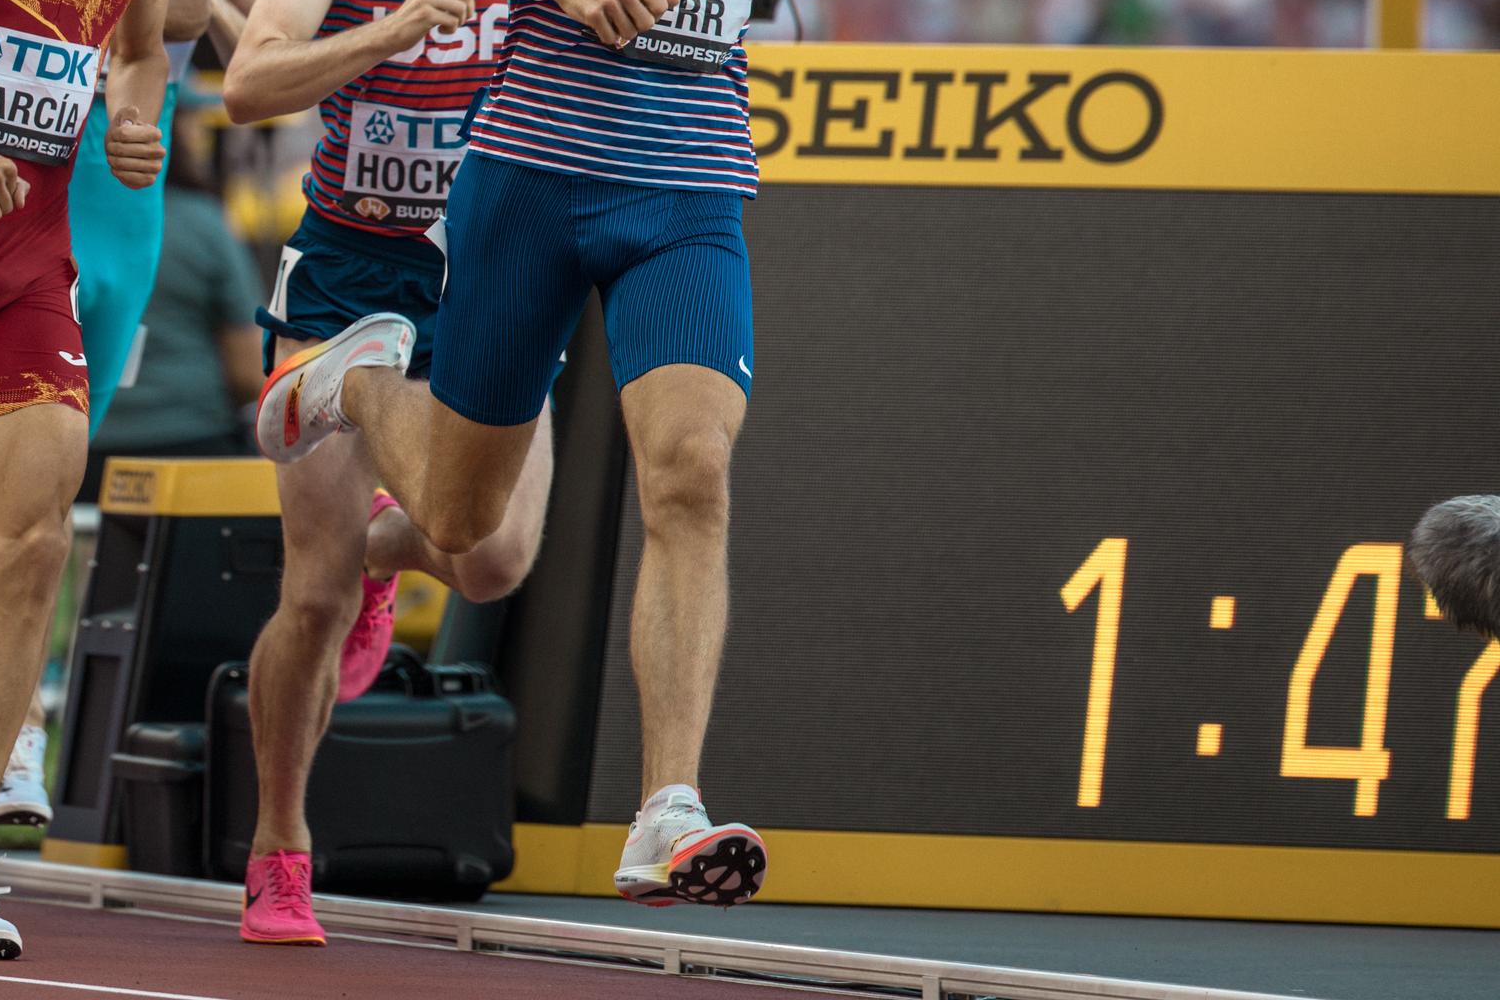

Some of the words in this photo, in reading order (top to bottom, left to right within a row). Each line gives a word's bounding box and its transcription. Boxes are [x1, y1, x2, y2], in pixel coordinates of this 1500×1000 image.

[6, 35, 94, 87] TDK
[396, 114, 470, 149] TD
[746, 68, 1164, 165] SEIKO
[356, 152, 460, 194] HOCK
